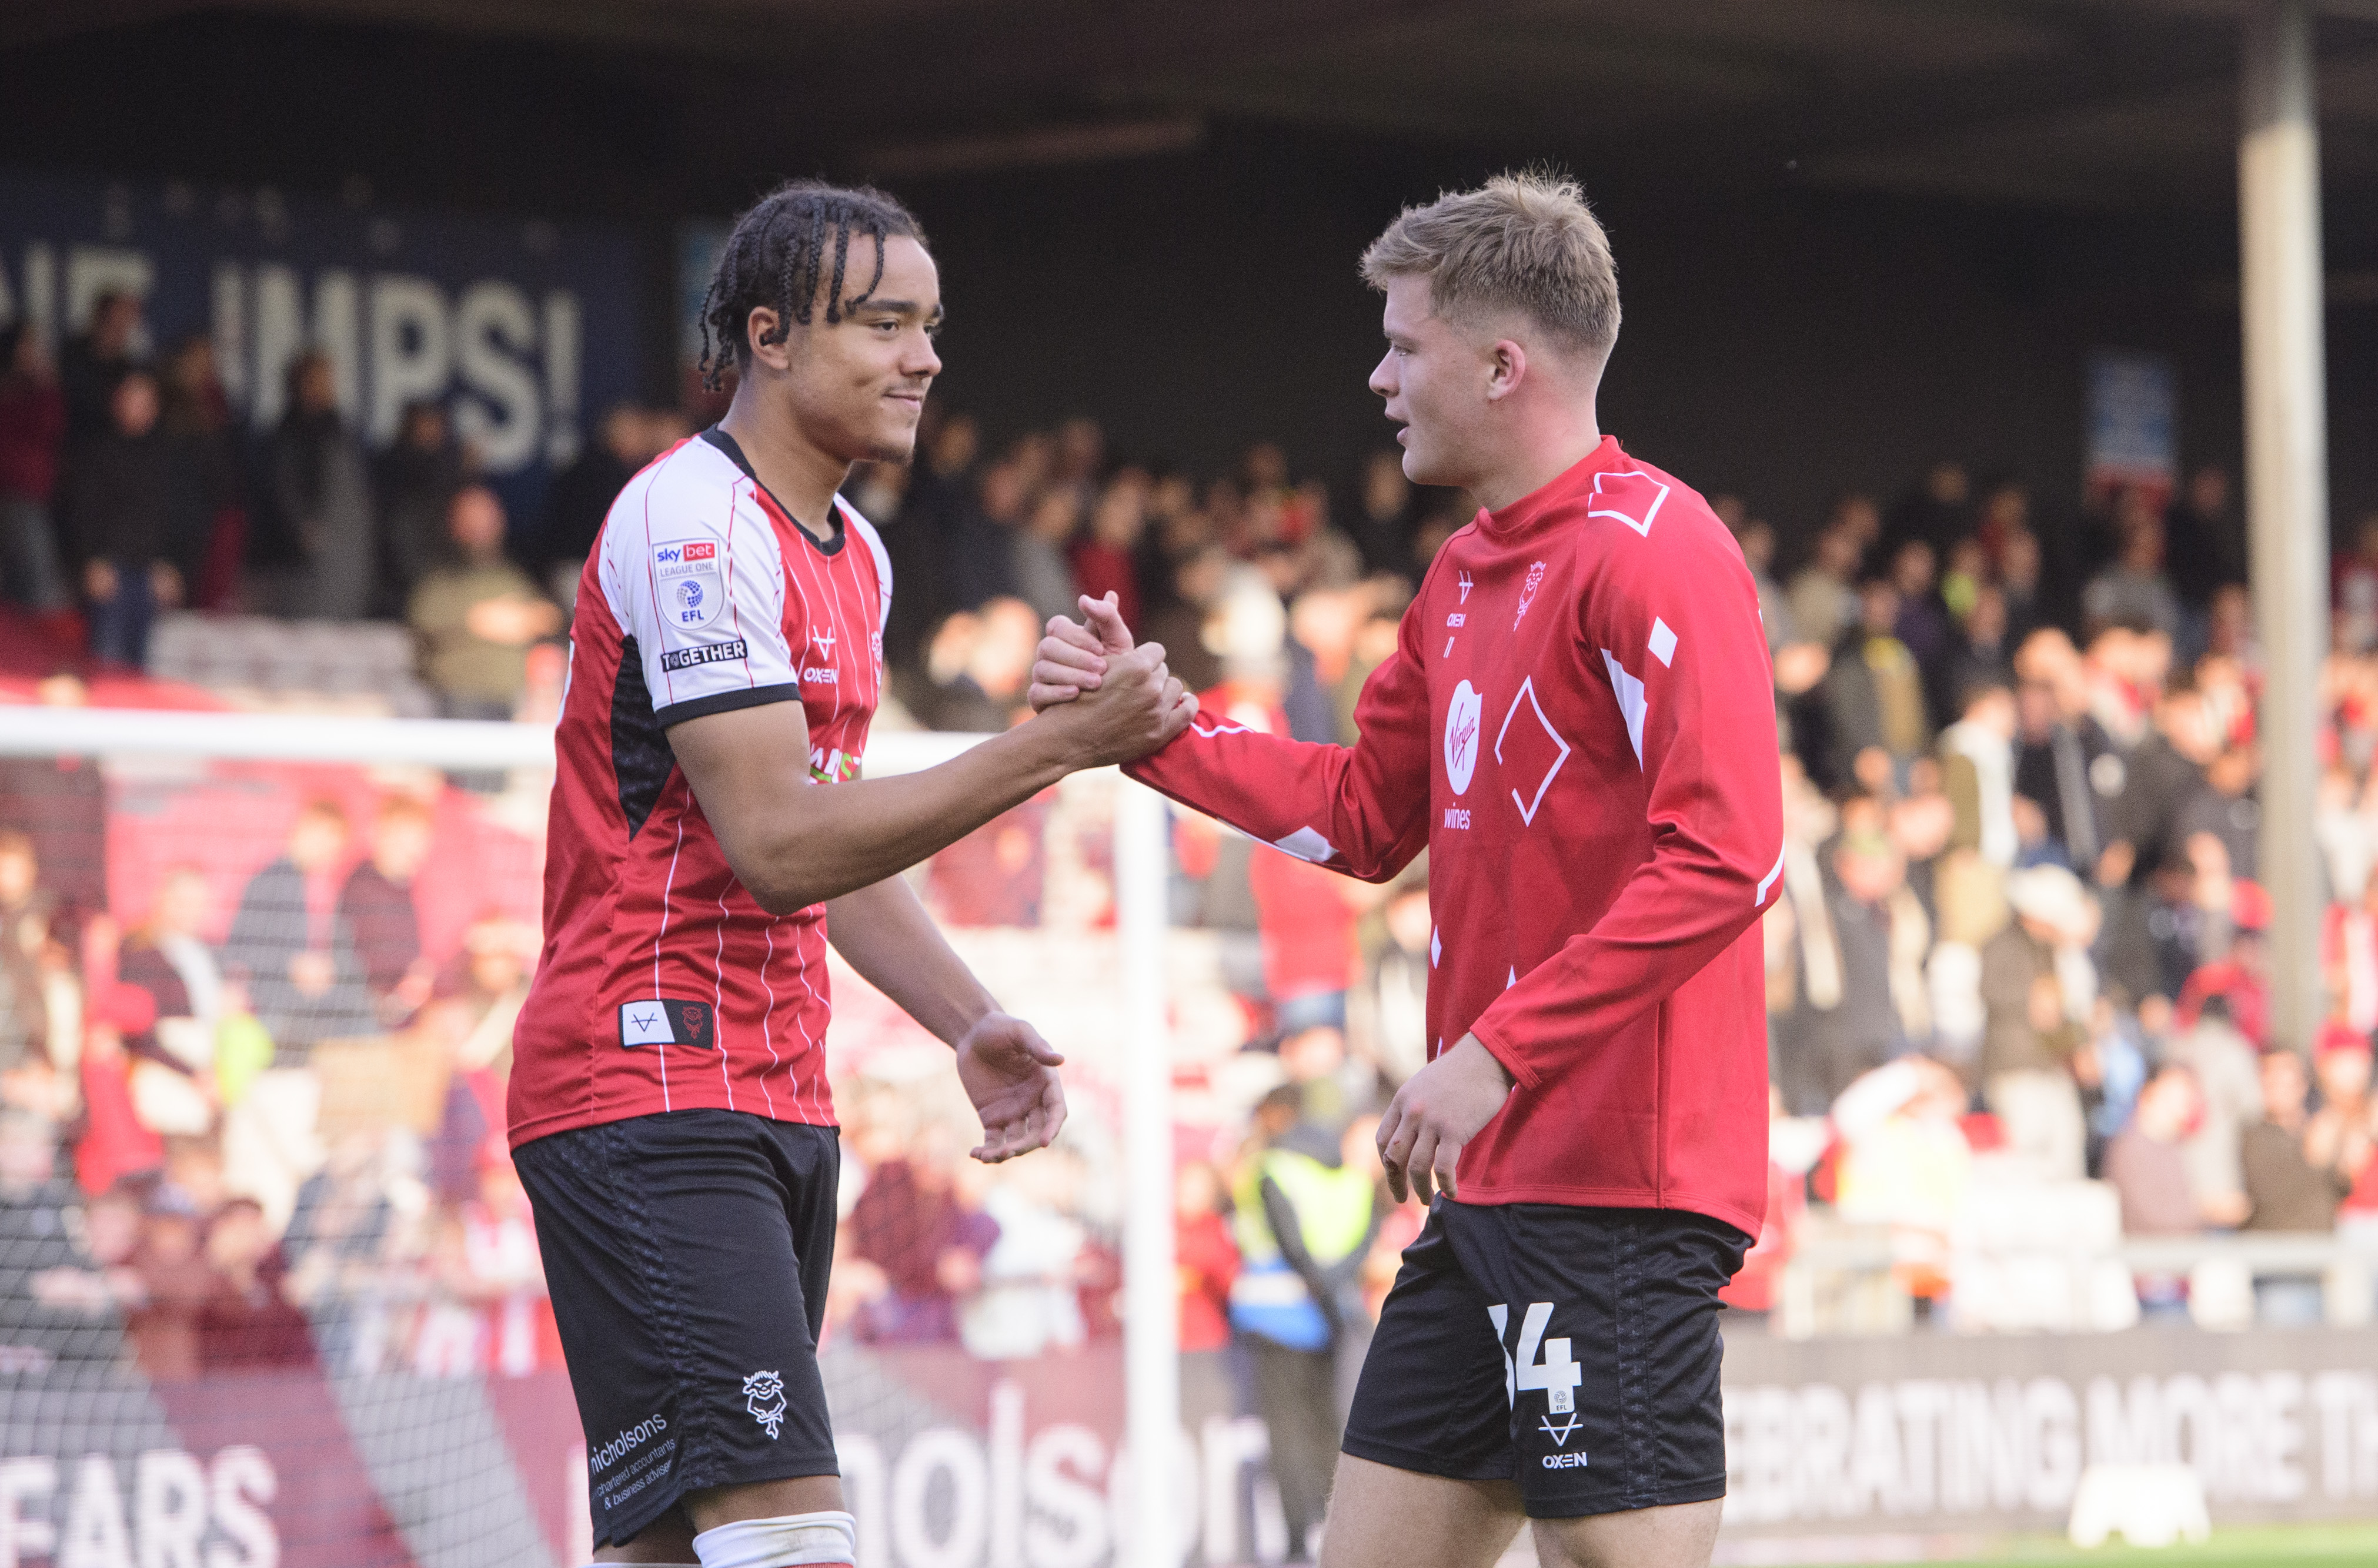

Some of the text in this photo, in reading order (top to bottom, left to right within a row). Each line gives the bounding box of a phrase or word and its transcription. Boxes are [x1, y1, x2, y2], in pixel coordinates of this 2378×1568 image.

[657, 544, 712, 563] sky bet
[660, 561, 714, 578] LEAGUE ONE
[682, 609, 704, 623] EFL
[1447, 613, 1467, 628] OXEN
[803, 667, 838, 685] OXEN
[1449, 701, 1475, 771] Virgin
[1444, 801, 1471, 831] wines
[590, 1413, 667, 1475] nicholsons
[597, 1439, 676, 1497] chartered accountants
[1542, 1451, 1588, 1469] OXEN
[604, 1497, 612, 1510] &
[613, 1478, 646, 1505] business
